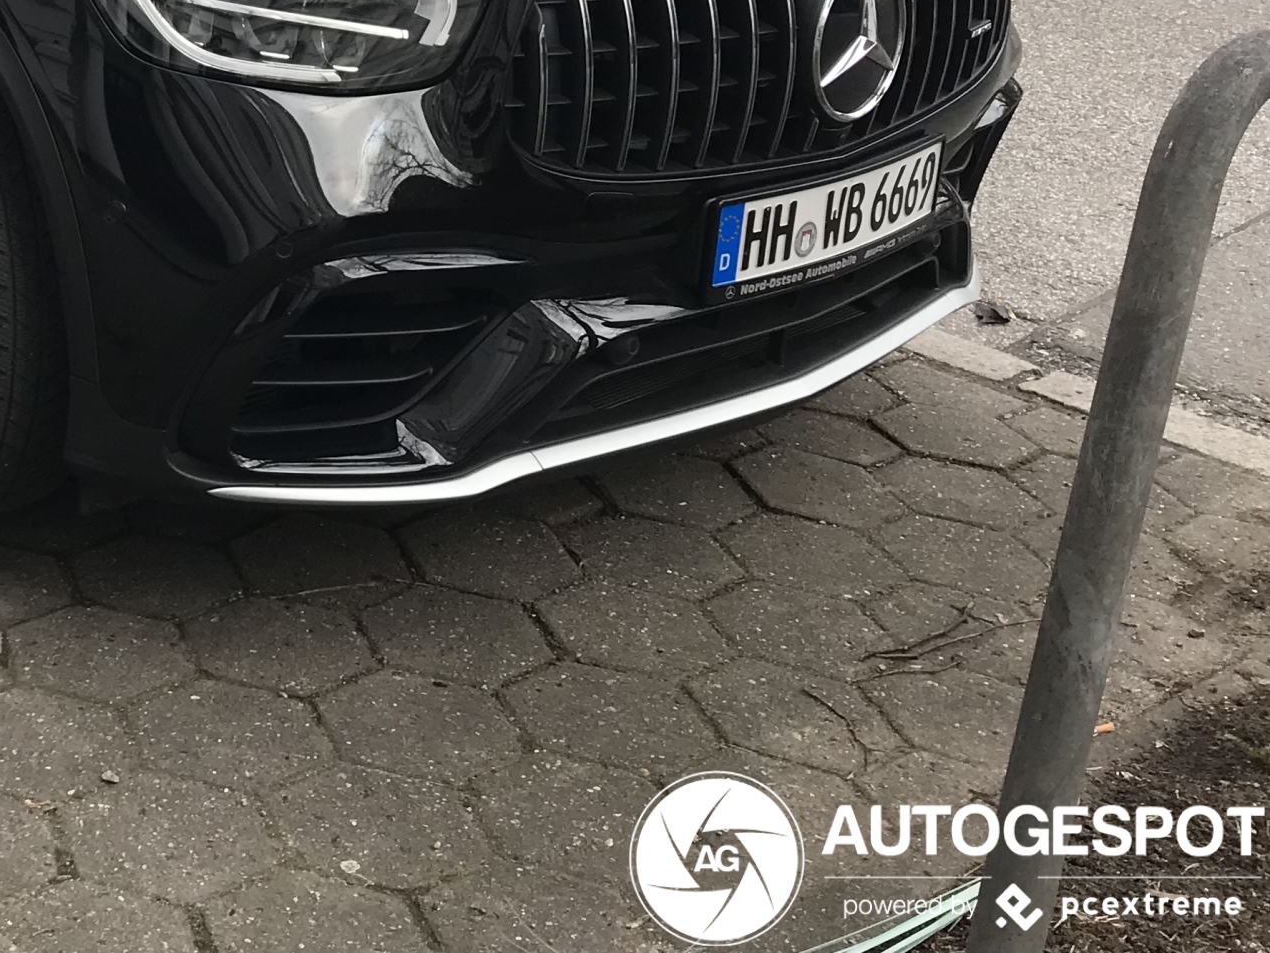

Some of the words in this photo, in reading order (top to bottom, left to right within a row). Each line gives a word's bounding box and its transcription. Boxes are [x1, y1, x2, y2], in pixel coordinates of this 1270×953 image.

[740, 201, 798, 271] HH
[823, 182, 866, 250] WB
[870, 151, 936, 232] 6669
[719, 253, 731, 272] D
[740, 271, 803, 296] Nord-Ostsee
[805, 254, 857, 279] Automobile
